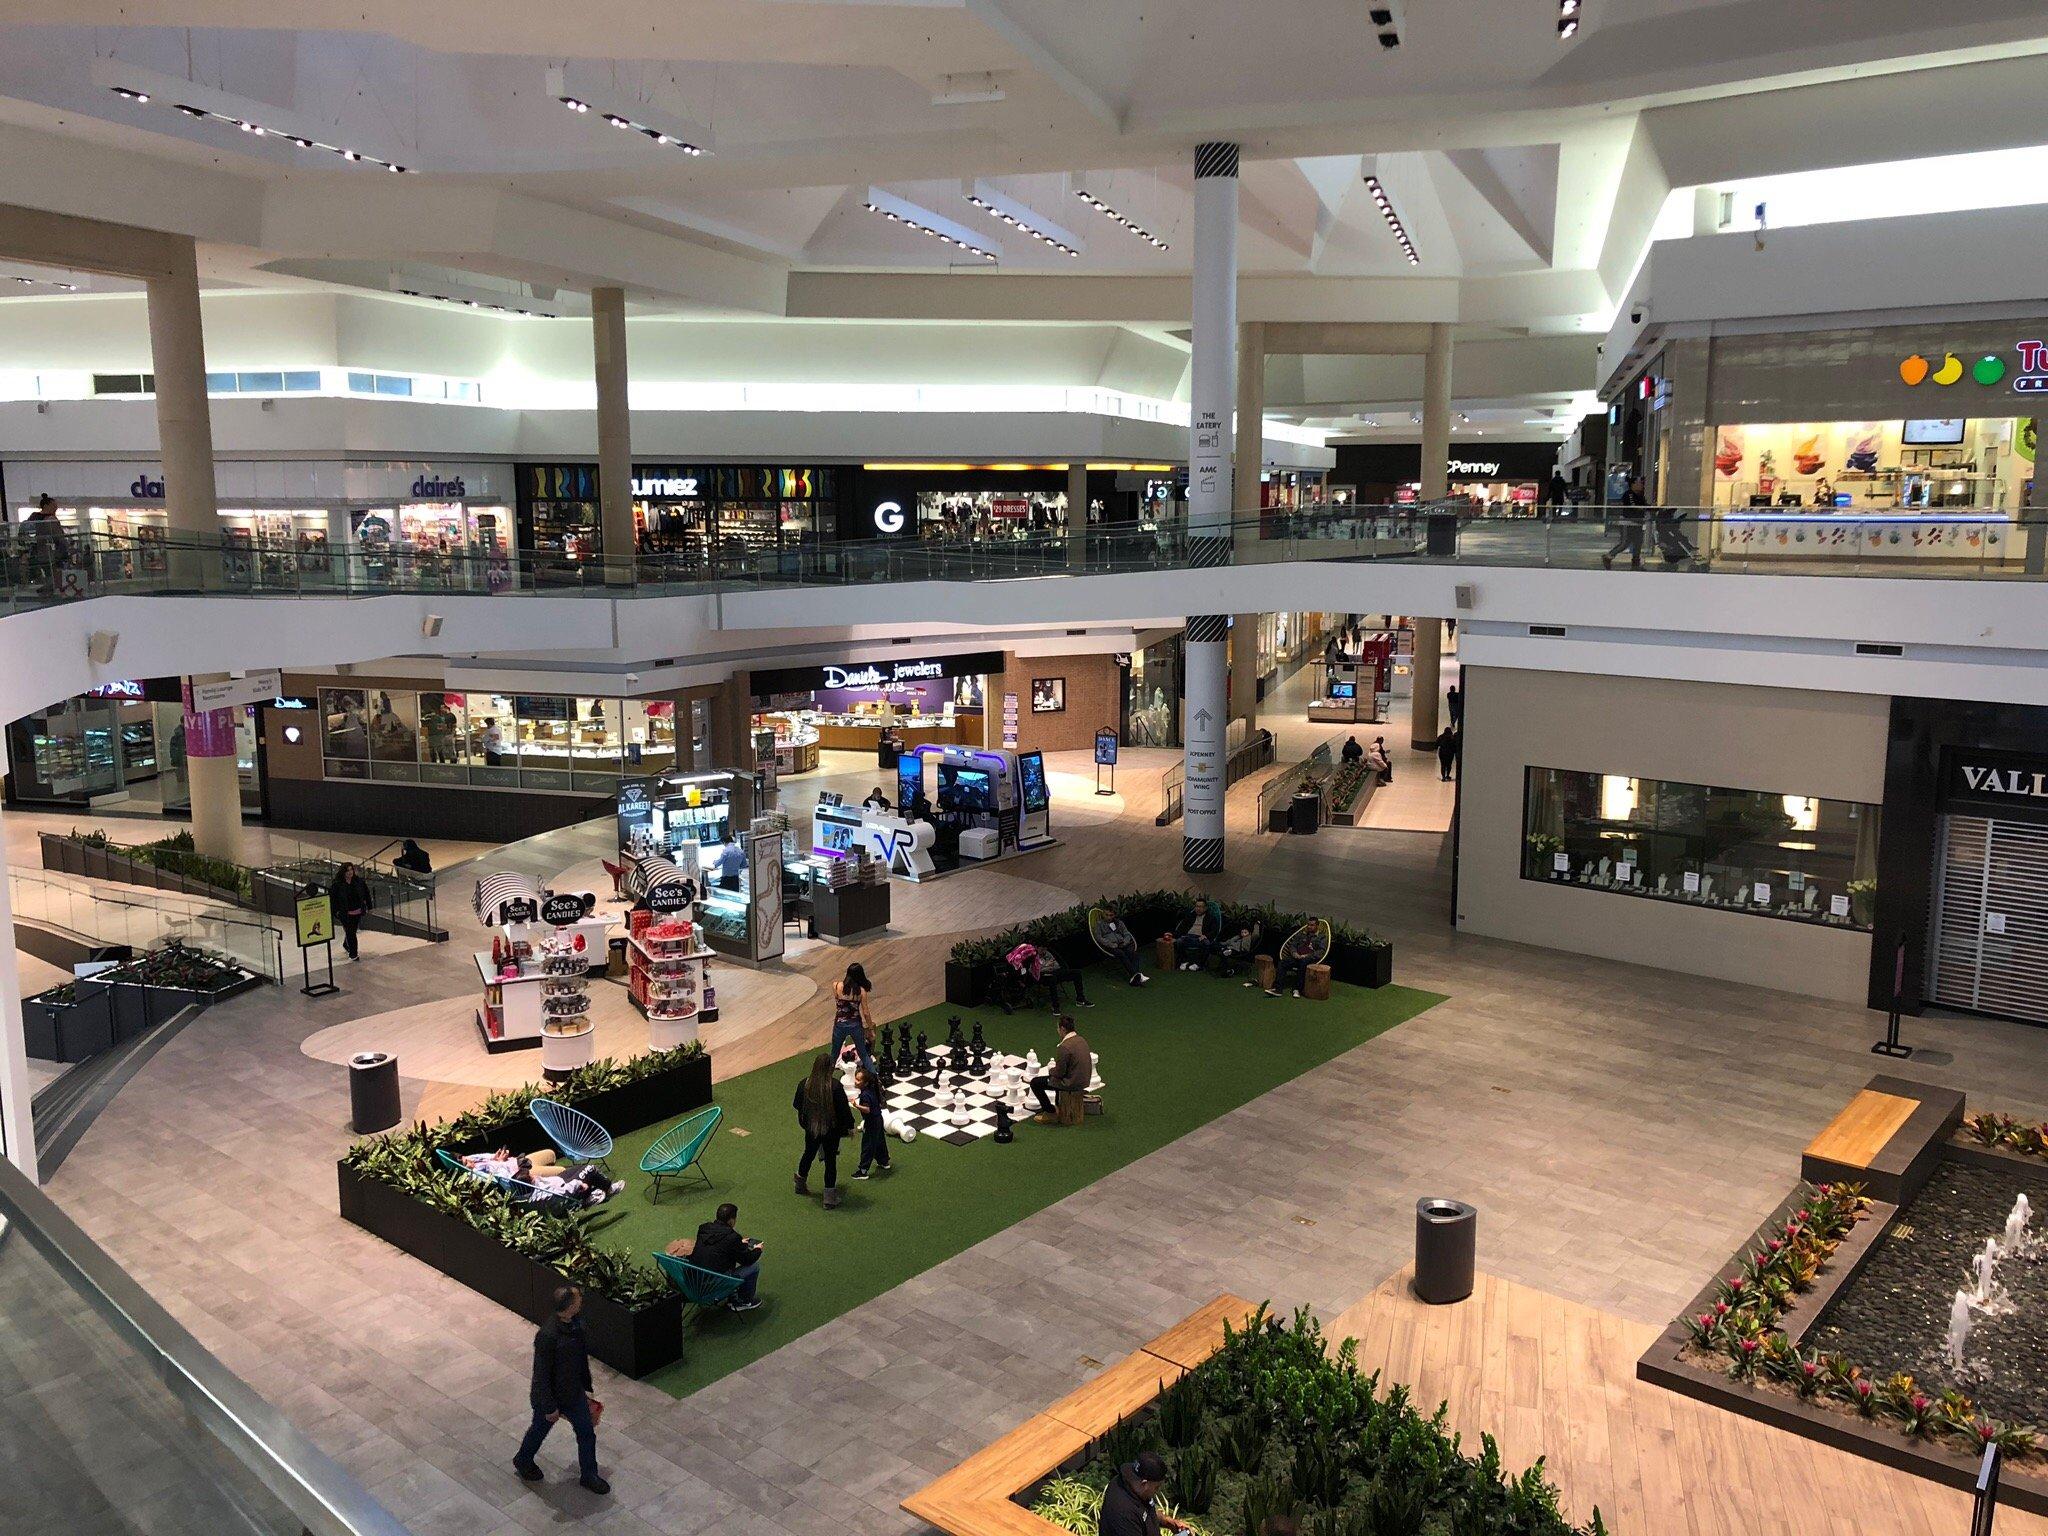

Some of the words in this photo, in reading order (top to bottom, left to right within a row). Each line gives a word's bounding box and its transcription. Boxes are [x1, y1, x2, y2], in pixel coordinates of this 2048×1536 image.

[1202, 412, 1215, 420] THE
[1196, 422, 1221, 430] EATERY
[1200, 466, 1217, 474] AMC
[412, 475, 466, 498] claire's
[630, 478, 698, 496] umiez
[1002, 505, 1026, 513] DRESSES
[874, 501, 905, 533] G
[892, 661, 942, 682] jewelers
[873, 829, 914, 868] VR
[655, 887, 683, 898] See's
[551, 900, 578, 911] See's
[651, 898, 687, 907] CANDIES
[546, 910, 580, 920] CANDIES
